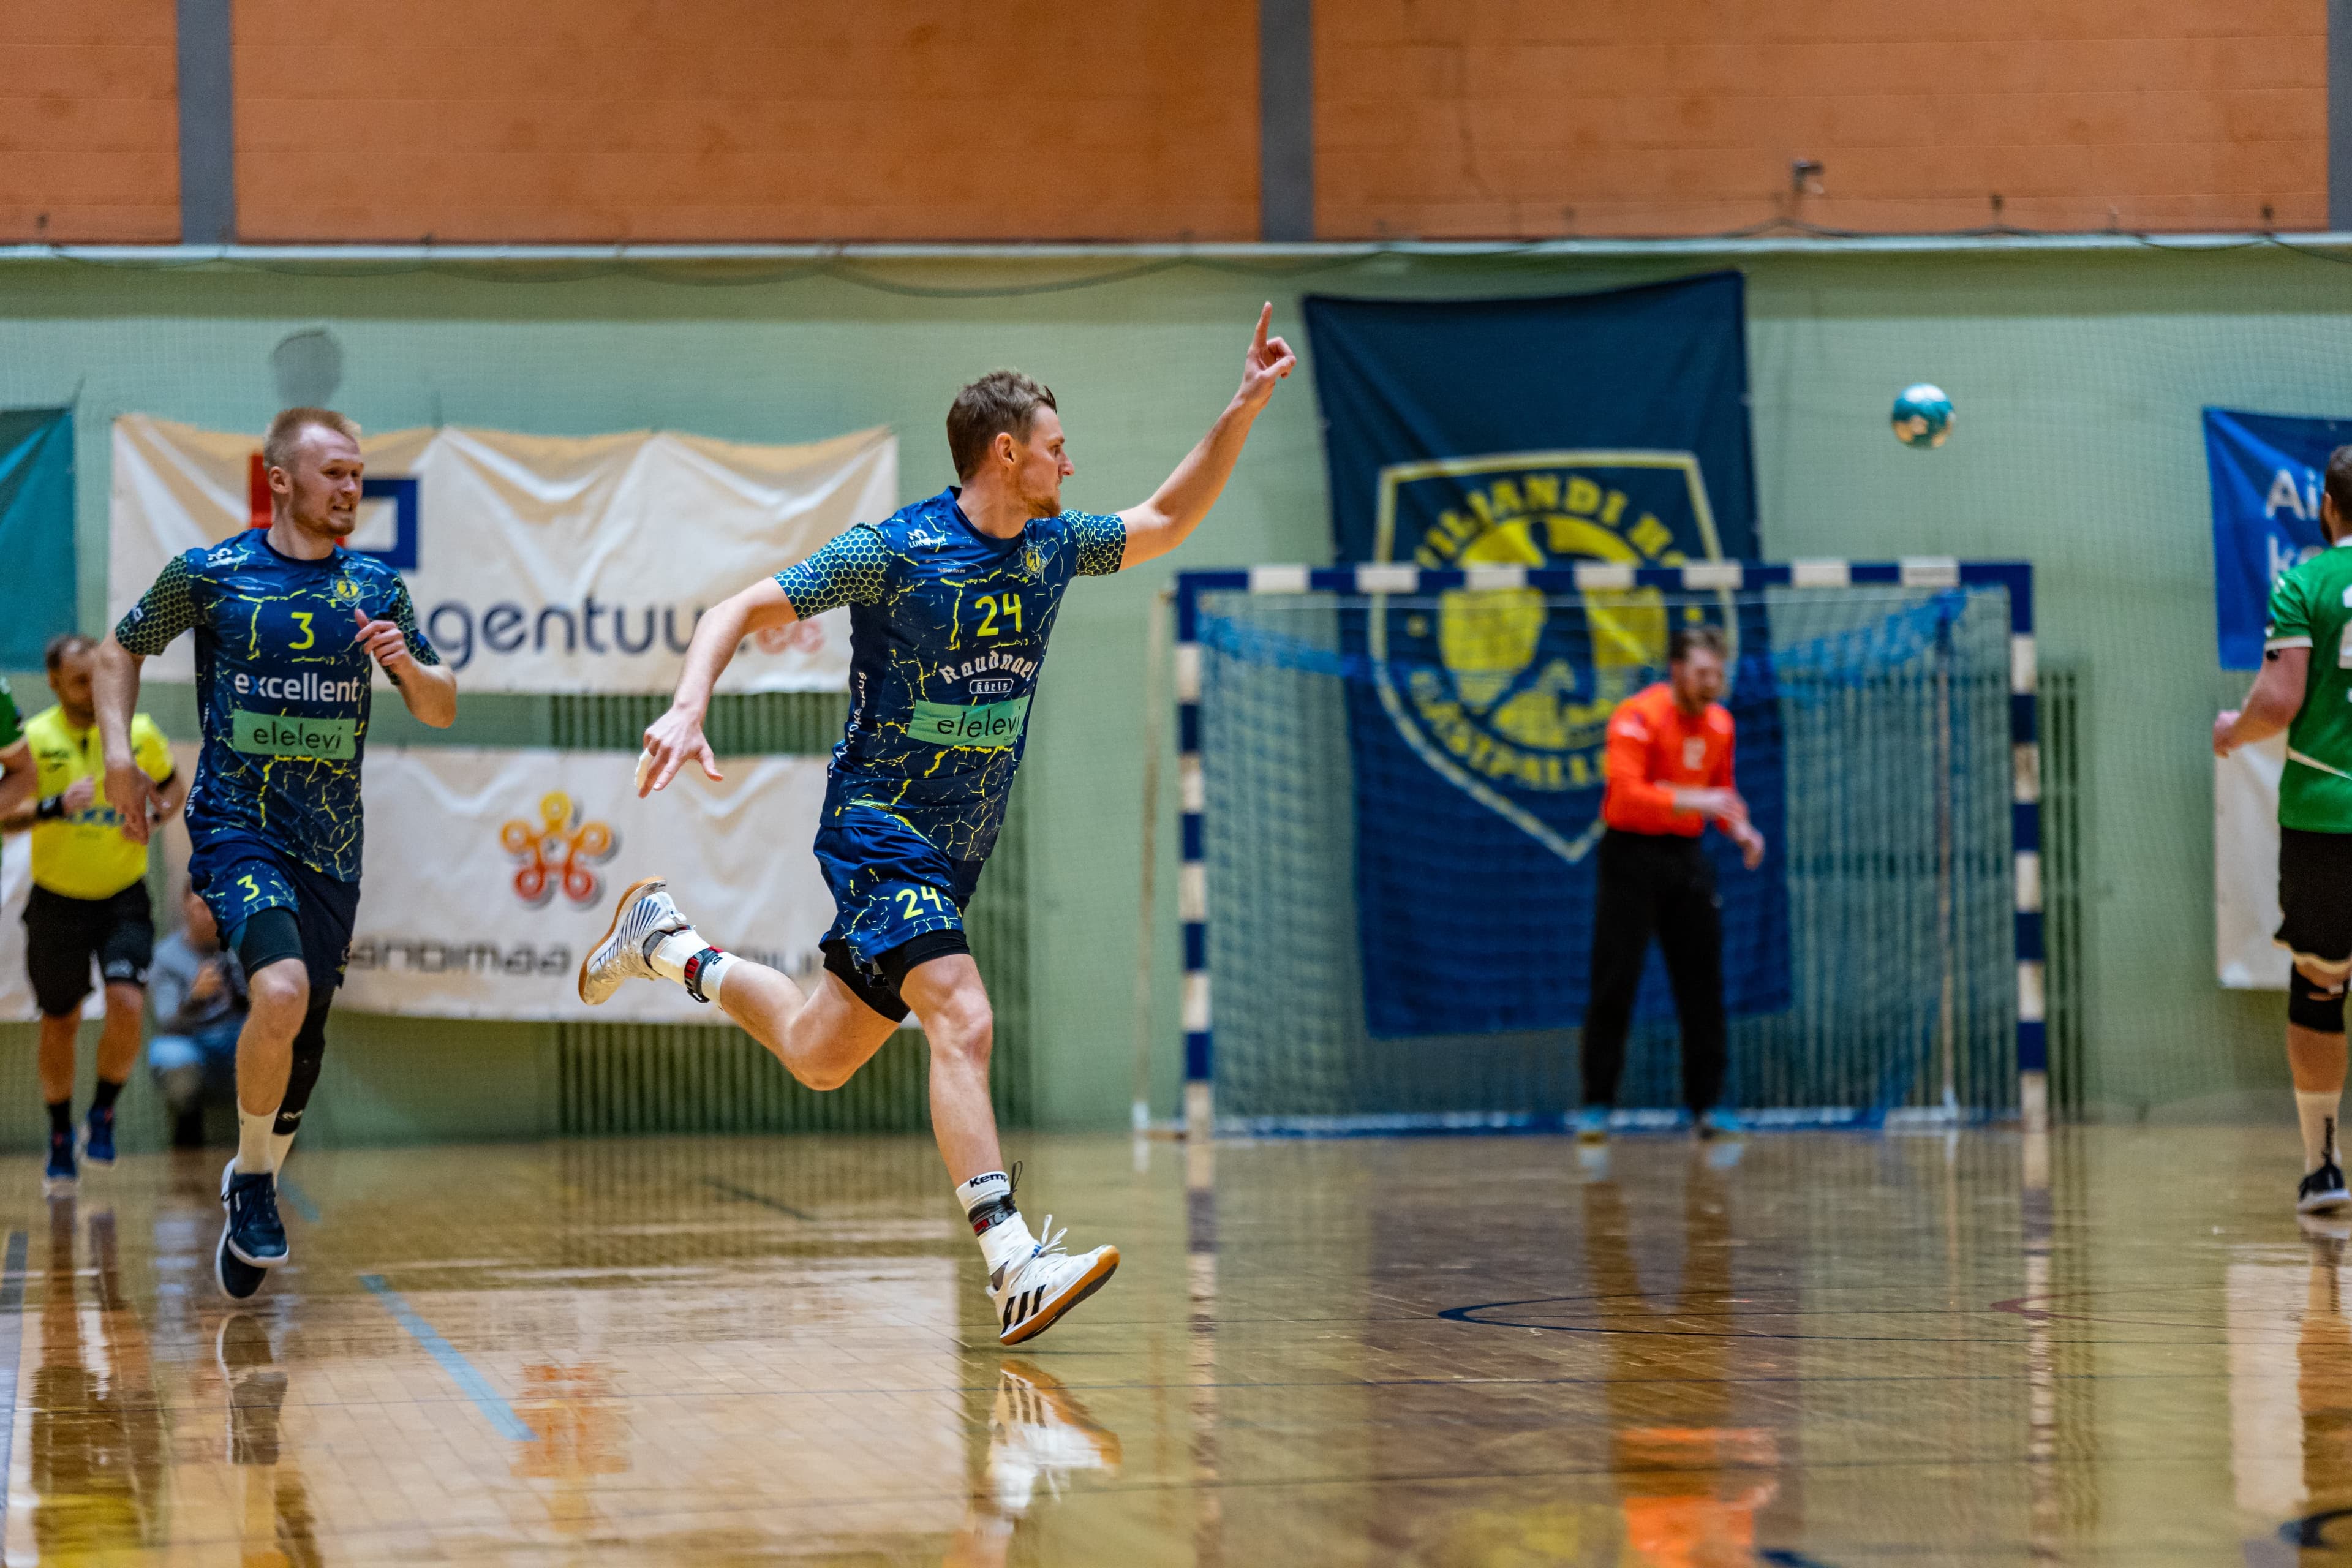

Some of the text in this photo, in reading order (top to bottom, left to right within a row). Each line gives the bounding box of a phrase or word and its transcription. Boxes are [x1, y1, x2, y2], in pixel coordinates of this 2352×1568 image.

[289, 612, 315, 649] 3
[427, 593, 827, 671] gentuu.ee
[974, 593, 1022, 637] 24
[938, 650, 1039, 684] Raudnael
[234, 672, 360, 703] excellent
[252, 721, 342, 749] elelevi
[937, 705, 1022, 738] elelevi
[237, 875, 260, 902] 3
[895, 886, 943, 920] 24
